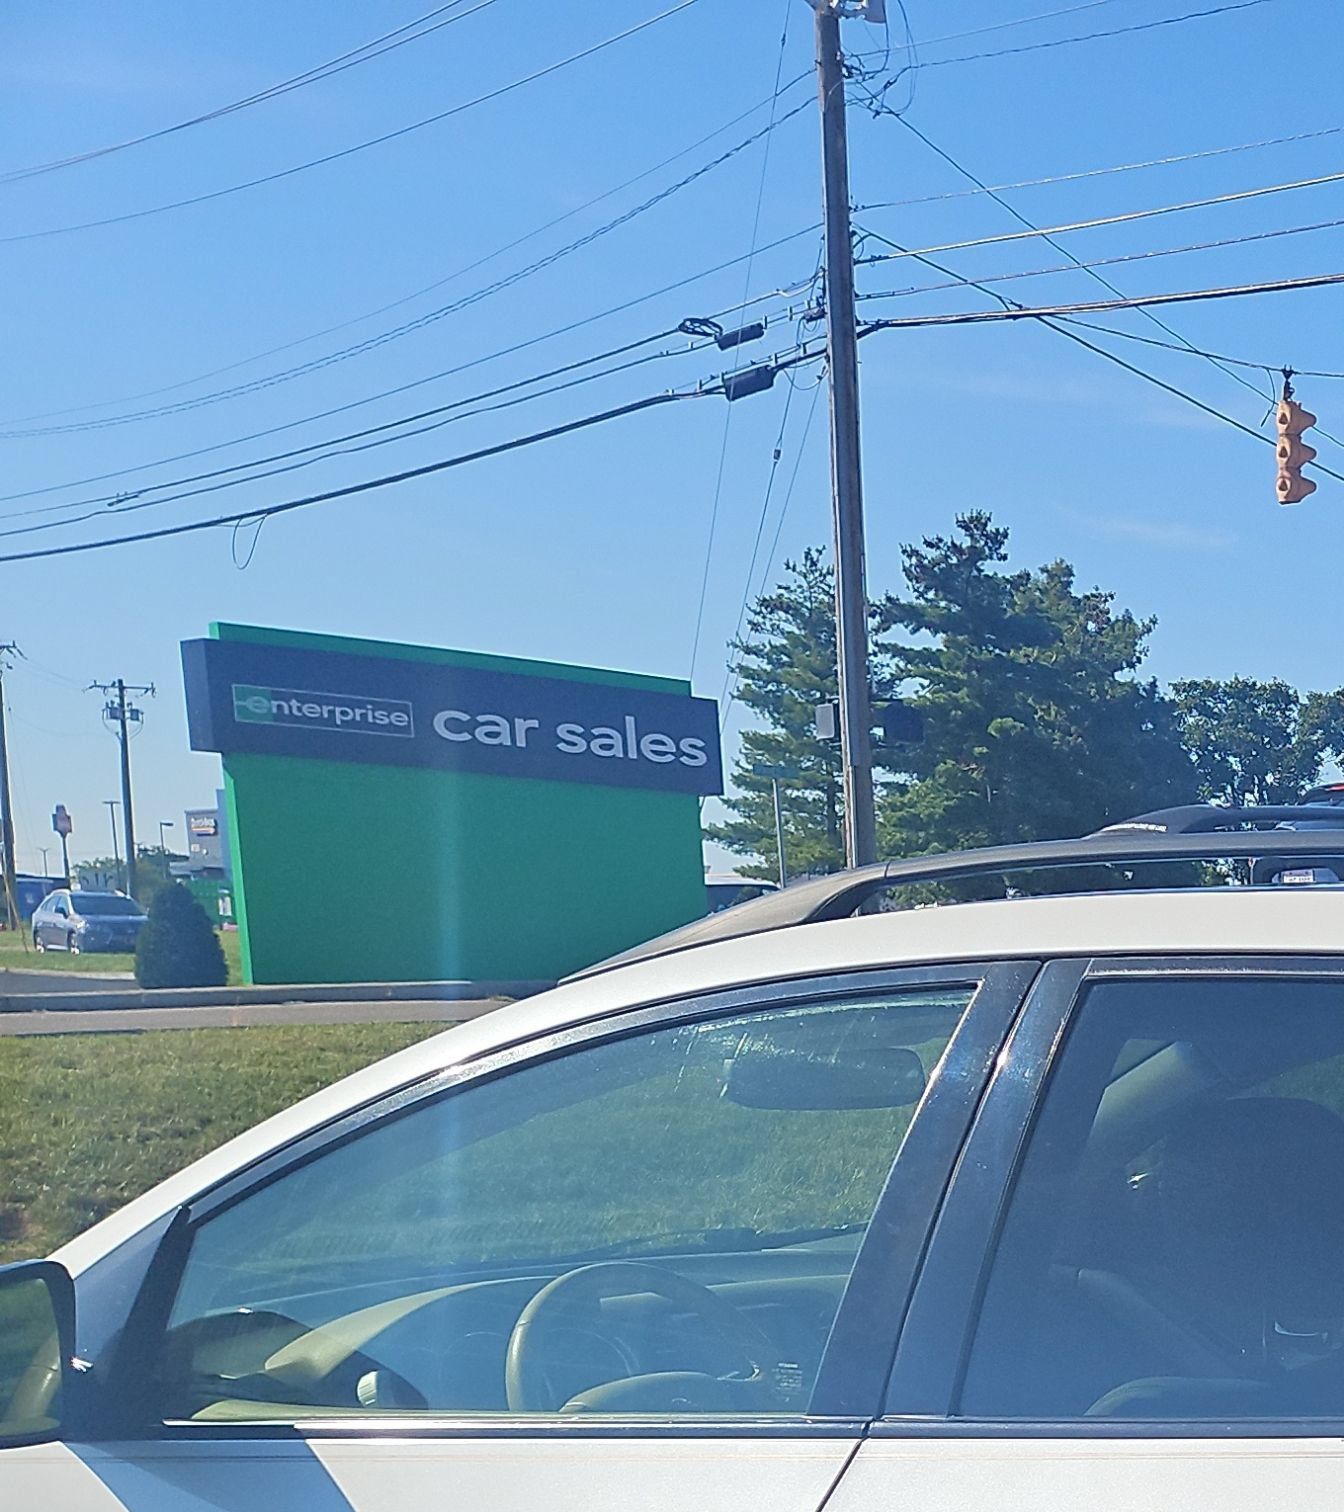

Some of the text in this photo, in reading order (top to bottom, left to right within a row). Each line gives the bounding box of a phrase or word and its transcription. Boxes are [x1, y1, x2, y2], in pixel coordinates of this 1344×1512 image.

[245, 695, 708, 767] enterprise car sales
